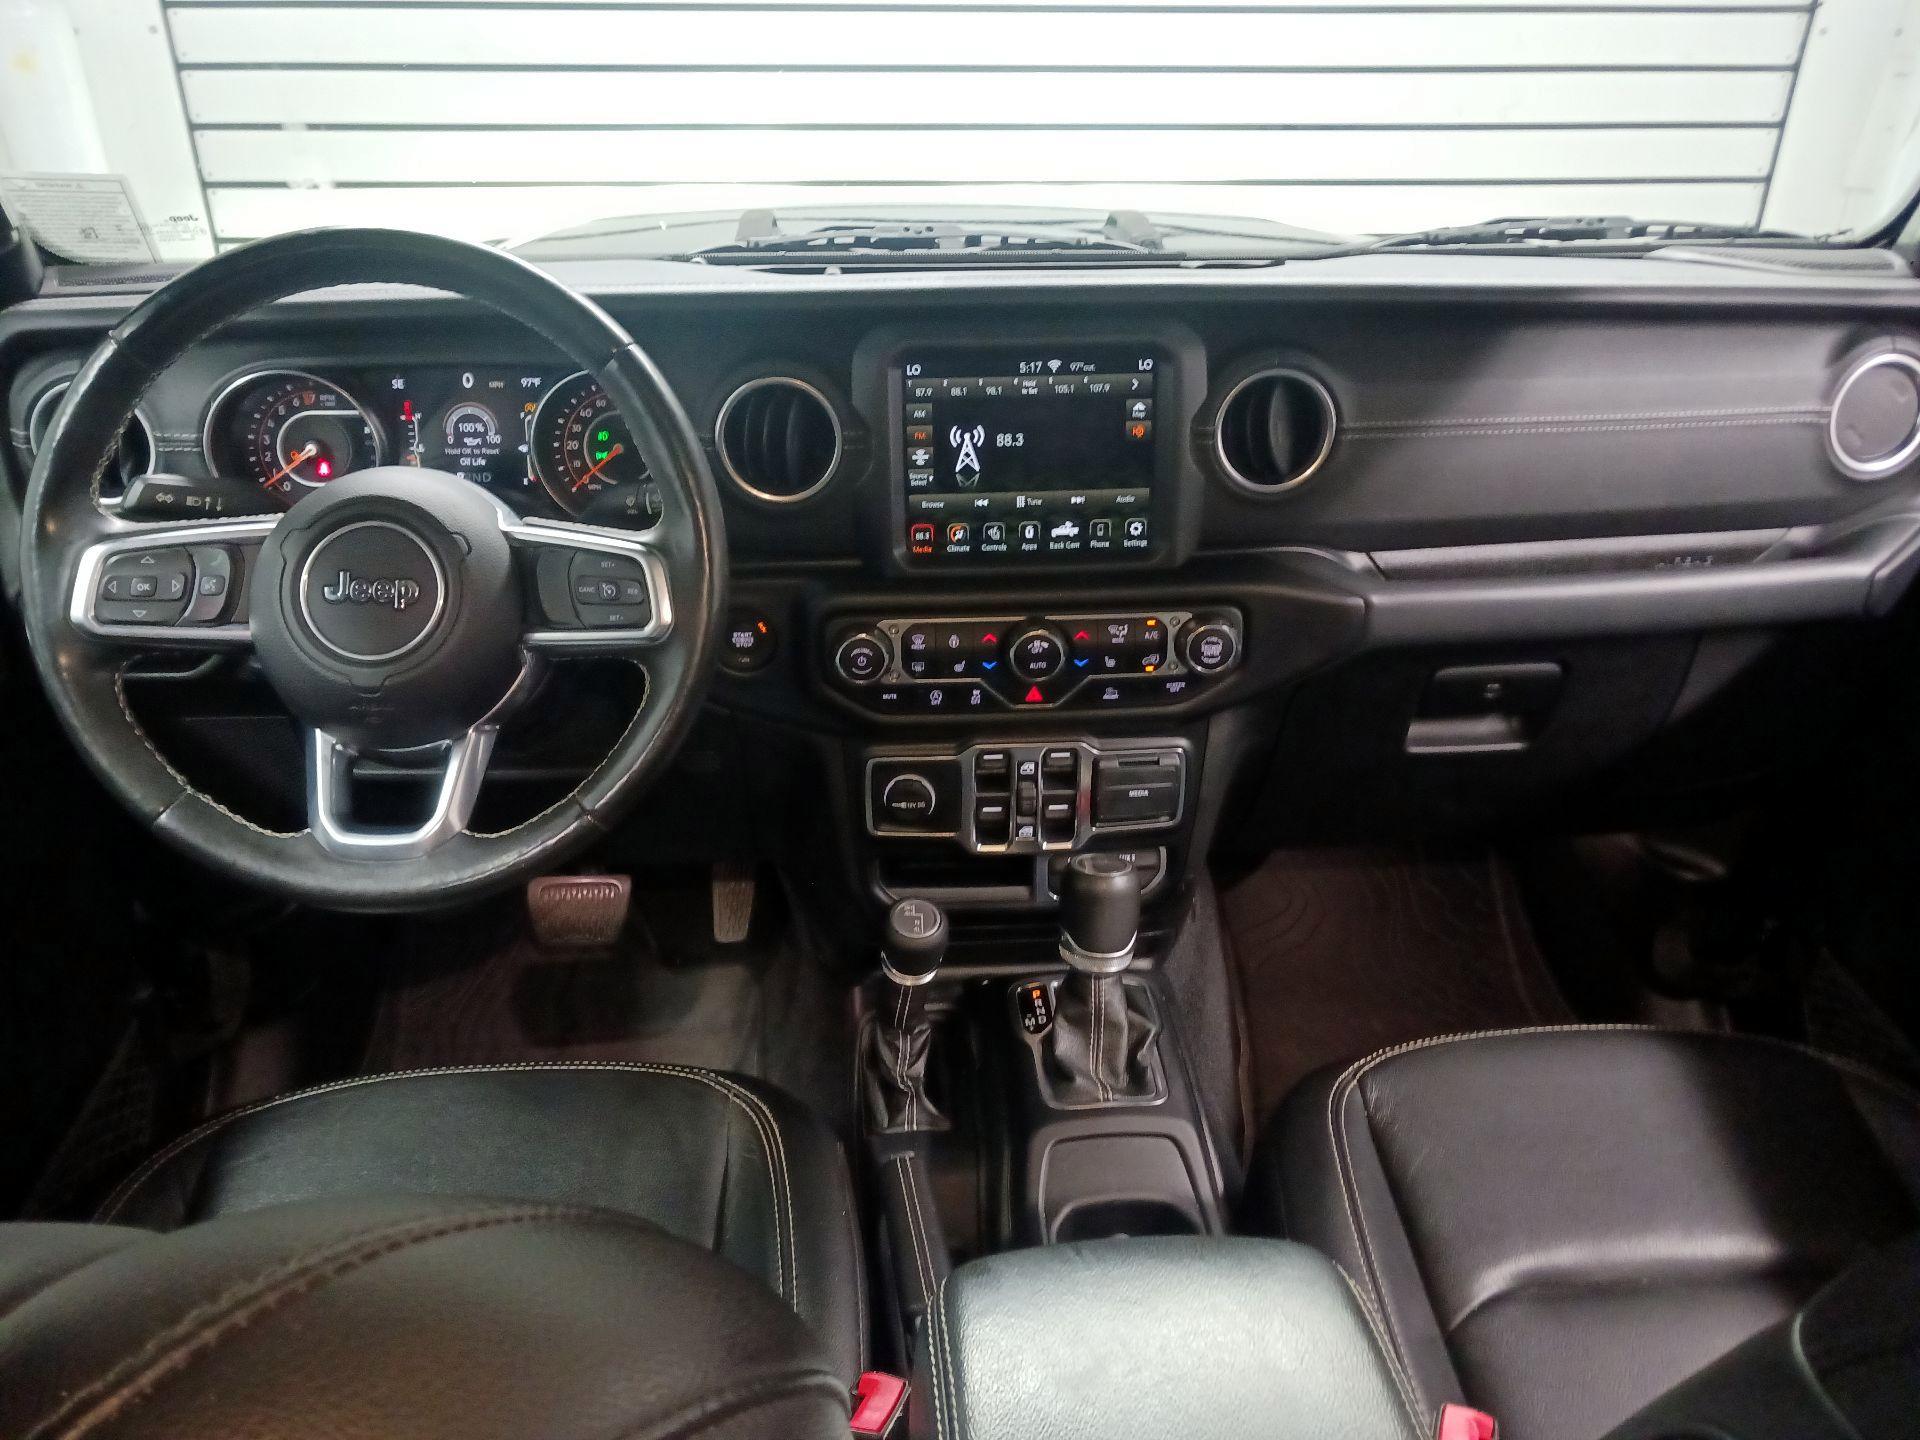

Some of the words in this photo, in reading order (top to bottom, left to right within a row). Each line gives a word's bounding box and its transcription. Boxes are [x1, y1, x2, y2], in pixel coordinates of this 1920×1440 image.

[1019, 361, 1042, 374] 5:17
[1139, 358, 1154, 371] LO
[906, 364, 922, 376] LO
[391, 378, 405, 389] SE
[462, 372, 474, 388] 0
[579, 408, 593, 418] 40
[913, 410, 926, 418] AM
[458, 422, 485, 433] 100%
[571, 424, 582, 433] 30
[447, 435, 454, 445] 0
[486, 435, 502, 444] 100
[914, 431, 927, 440] FM
[996, 432, 1025, 447] 88.3
[566, 441, 579, 450] 20
[264, 451, 272, 462] 2
[946, 544, 971, 553] Climate
[137, 582, 152, 592] OK
[323, 571, 420, 609] Jeep
[1029, 661, 1047, 669] AUTO
[1036, 1006, 1045, 1015] N
[1025, 1017, 1036, 1027] M
[1038, 1015, 1046, 1024] D
